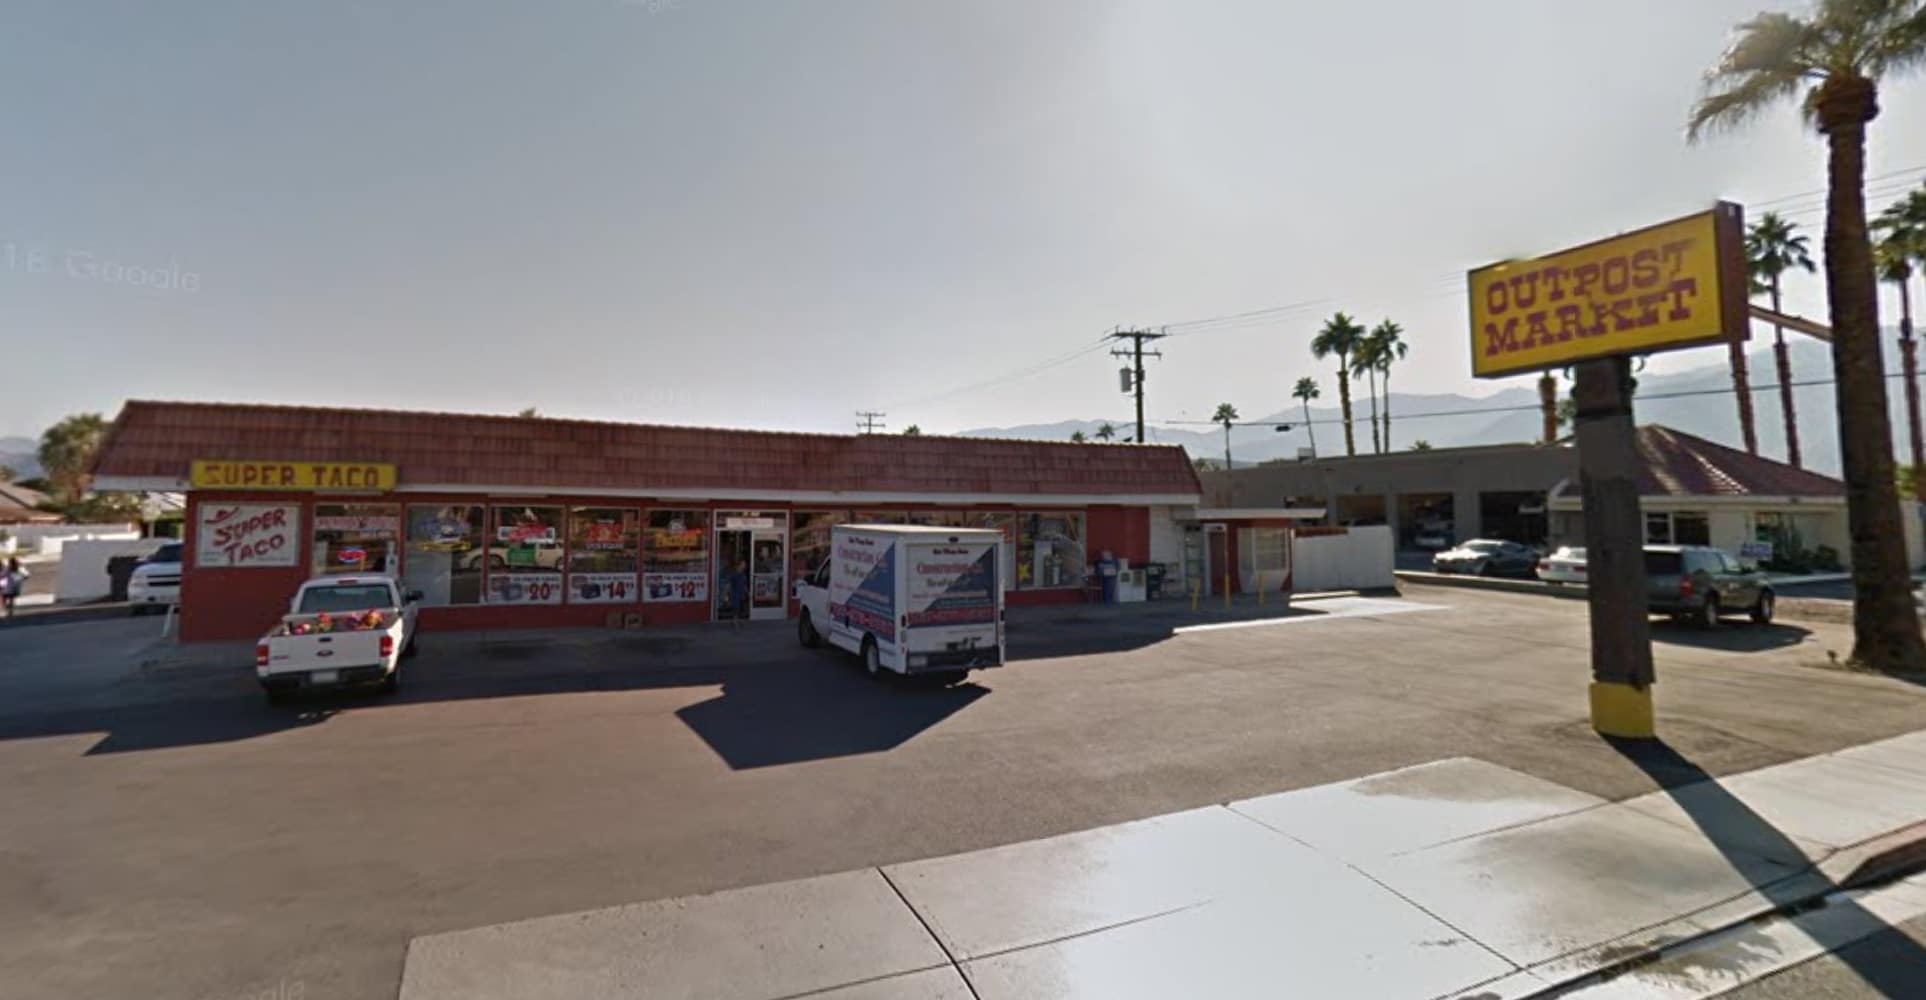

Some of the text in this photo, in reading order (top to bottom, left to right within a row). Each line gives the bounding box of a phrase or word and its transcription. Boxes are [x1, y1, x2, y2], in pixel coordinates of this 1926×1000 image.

[1486, 240, 1695, 315] OUTPOST
[1485, 277, 1697, 357] MARKET
[204, 464, 380, 488] SUPER TACO
[213, 508, 287, 545] SUPER
[224, 534, 285, 562] TACO
